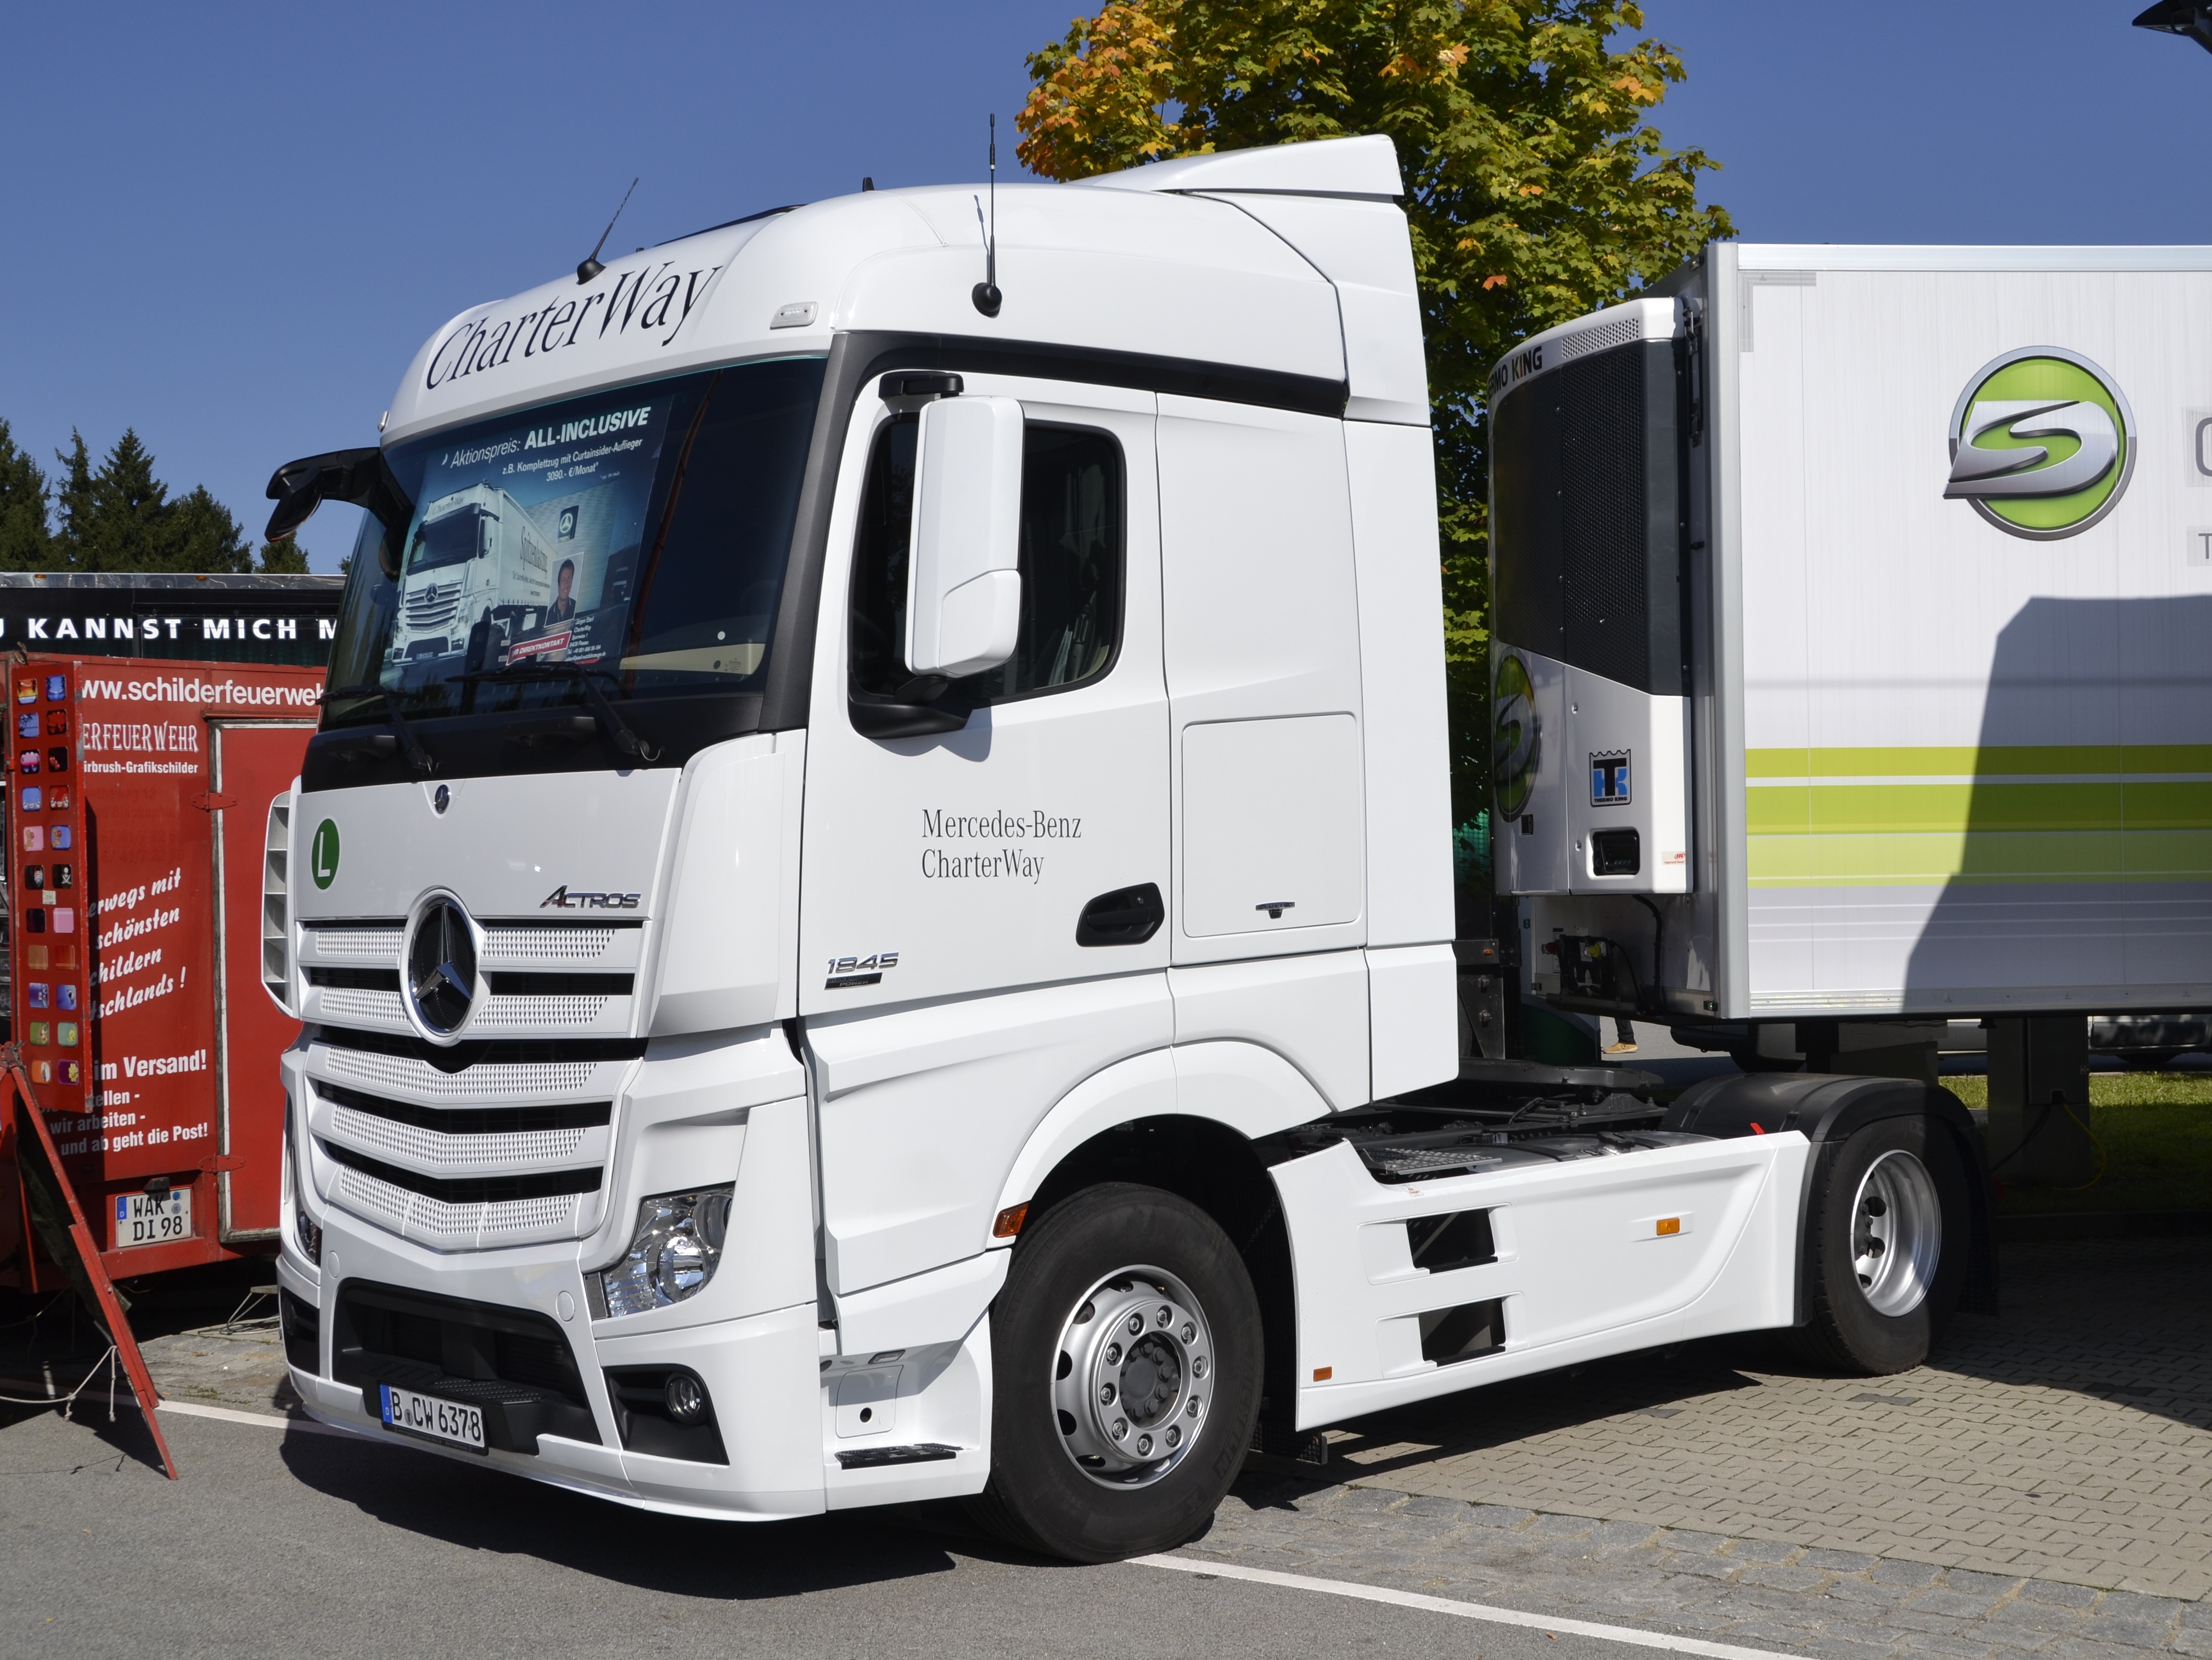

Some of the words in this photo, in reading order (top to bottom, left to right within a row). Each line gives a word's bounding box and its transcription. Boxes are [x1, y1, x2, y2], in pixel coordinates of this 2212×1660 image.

[426, 260, 723, 390] CharterWay
[1512, 346, 1542, 382] KING
[450, 438, 521, 468] Aktionspreis:
[524, 407, 652, 449] ALL-INCLUSIVE
[502, 464, 515, 475] z.B.
[517, 457, 559, 474] Komplettzug
[560, 454, 571, 465] mit
[572, 439, 643, 462] Curtainsider-Auflieger
[28, 618, 182, 639] KANNST
[203, 618, 296, 639] MICH
[84, 761, 198, 774] irbrush-Grafikschilder
[922, 809, 1082, 838] Mercedes-Benz
[318, 831, 330, 877] L
[922, 848, 1045, 885] CharterWay
[151, 867, 181, 896] mit
[96, 908, 179, 950] schönsten
[827, 952, 899, 974] 1845
[123, 1049, 207, 1078] Versand!
[50, 1118, 73, 1135] wir
[77, 1112, 136, 1132] arbeiten
[61, 1138, 87, 1156] und
[92, 1135, 109, 1151] ab
[113, 1130, 144, 1152] geht
[148, 1128, 169, 1145] die
[173, 1122, 208, 1141] Post!
[133, 1195, 164, 1218] WAK
[133, 1219, 156, 1241] DI
[161, 1216, 182, 1237] 98
[391, 1391, 402, 1421] B
[412, 1397, 434, 1431] CW
[439, 1403, 481, 1442] 6378
